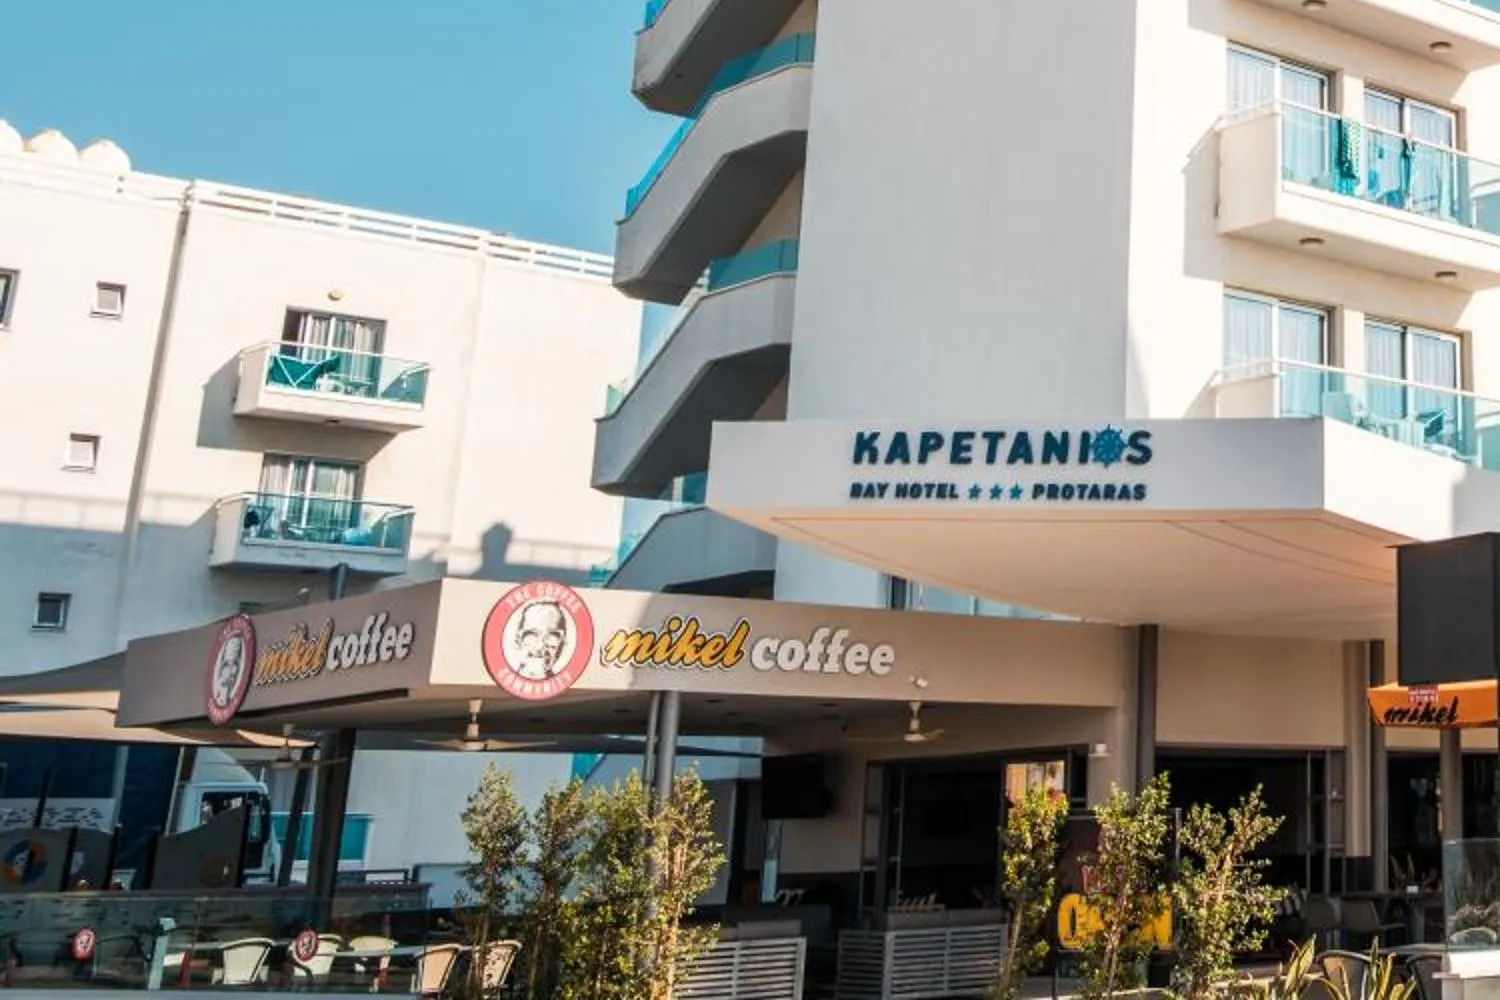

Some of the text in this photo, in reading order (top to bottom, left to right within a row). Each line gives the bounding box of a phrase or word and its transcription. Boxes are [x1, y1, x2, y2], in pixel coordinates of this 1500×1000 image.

[852, 424, 1153, 467] KAPETANIOS
[850, 483, 1147, 500] BAY HOTEL PROTARAS
[326, 611, 414, 671] coffee
[601, 615, 896, 675] mikel coffee
[1384, 695, 1458, 724] mikel
